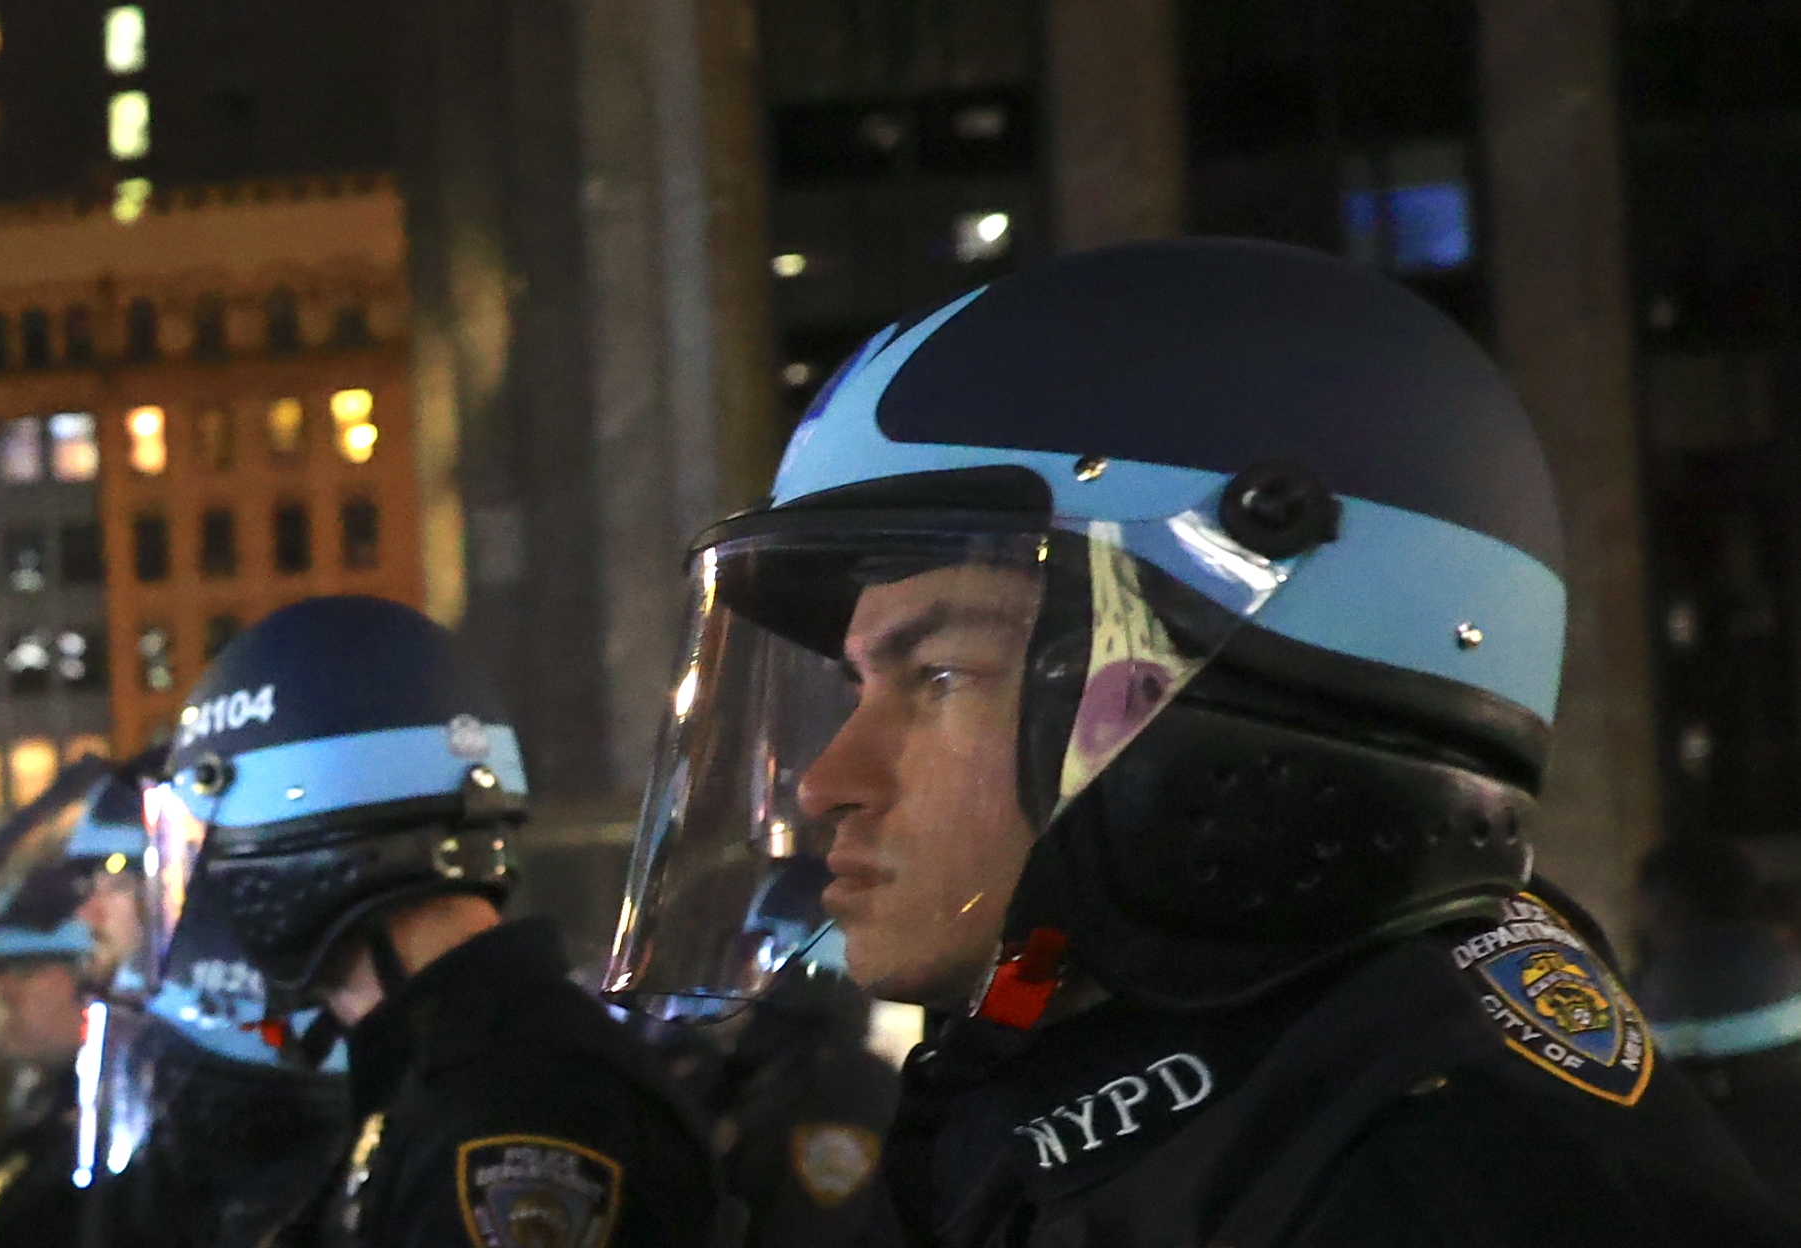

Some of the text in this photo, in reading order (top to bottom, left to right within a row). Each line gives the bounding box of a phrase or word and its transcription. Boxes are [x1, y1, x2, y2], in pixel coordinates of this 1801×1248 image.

[1481, 995, 1541, 1042] CITY
[1544, 1043, 1586, 1069] OF
[1013, 1053, 1213, 1168] NYPD
